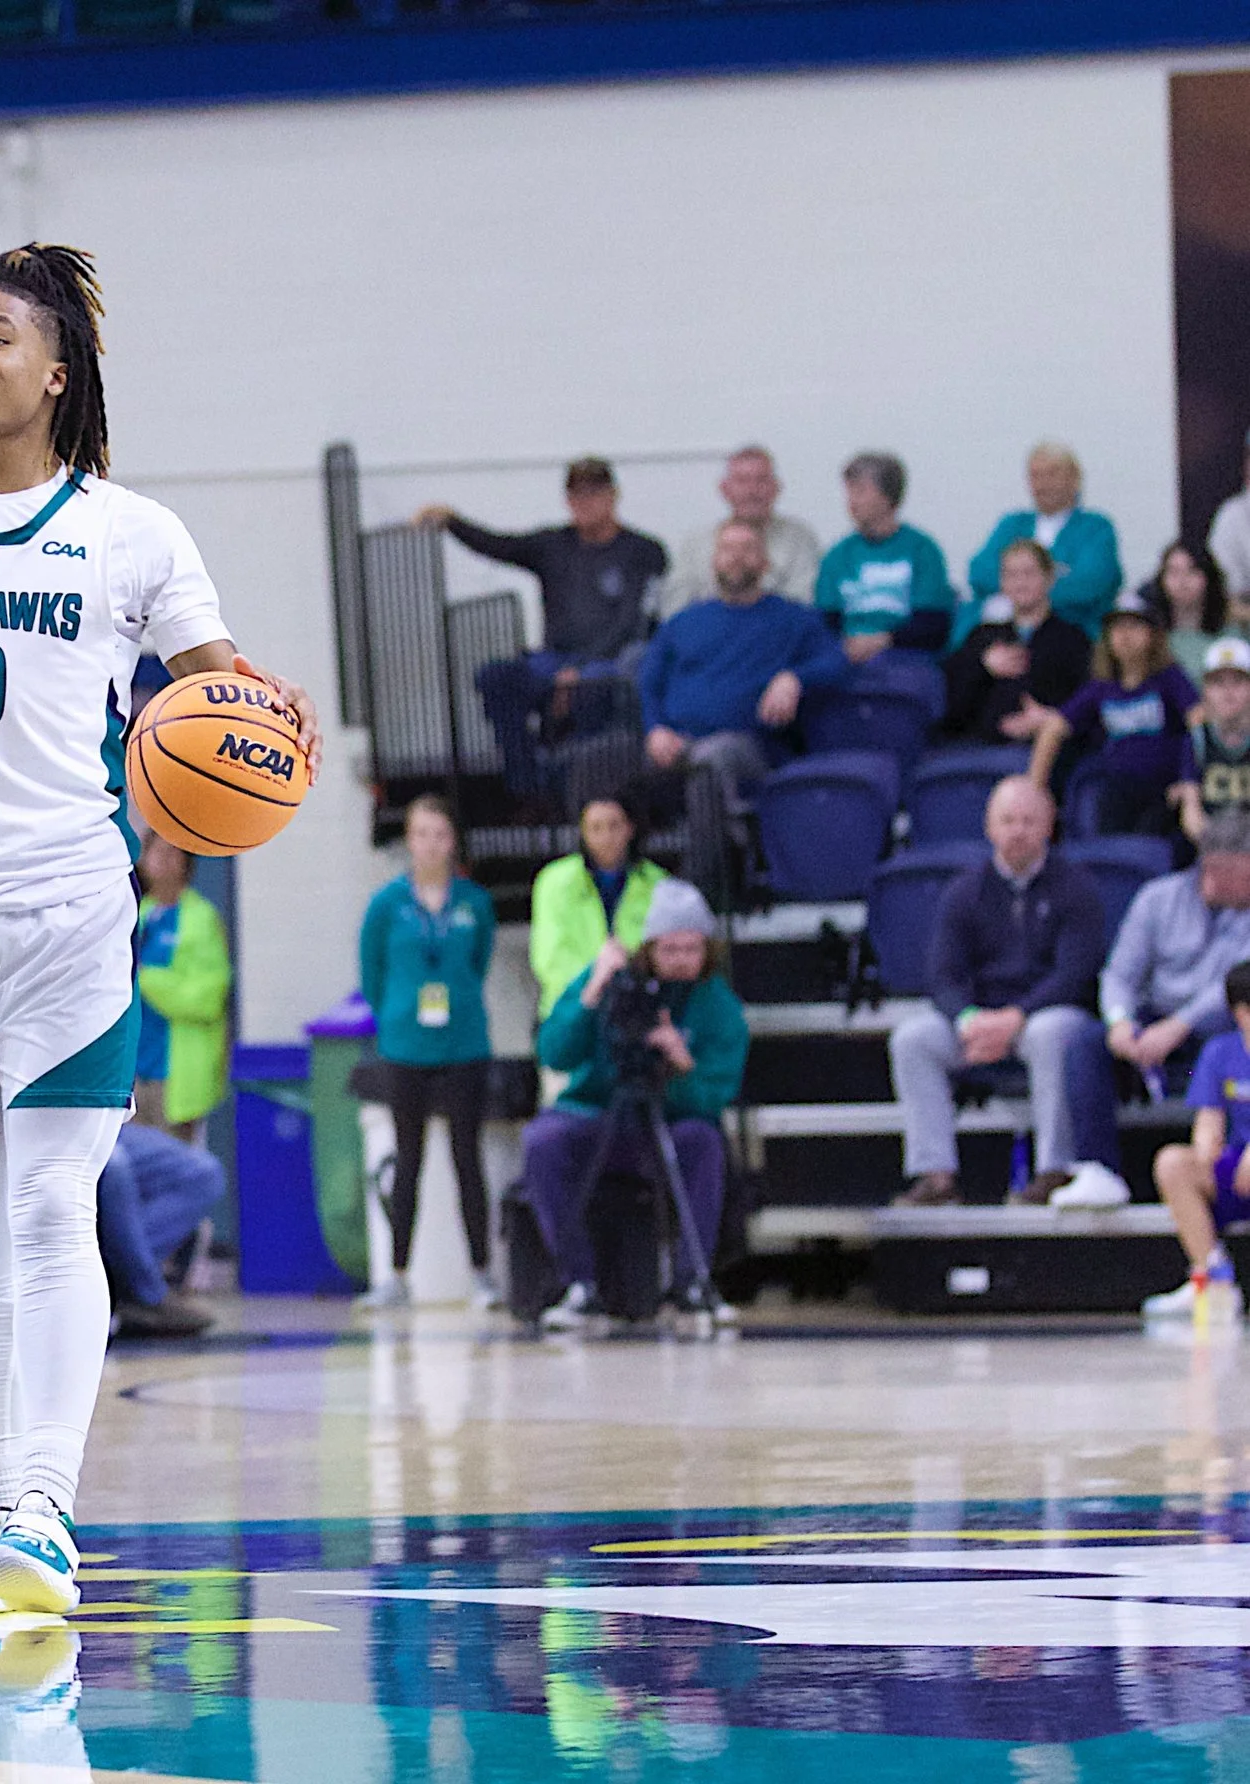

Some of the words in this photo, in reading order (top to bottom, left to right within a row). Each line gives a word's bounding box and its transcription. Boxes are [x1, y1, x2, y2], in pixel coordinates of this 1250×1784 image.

[41, 540, 87, 560] CAA
[212, 757, 249, 773] OFFICIAL
[250, 769, 273, 781] GAME
[273, 778, 288, 790] BALL
[216, 733, 294, 781] NCAA
